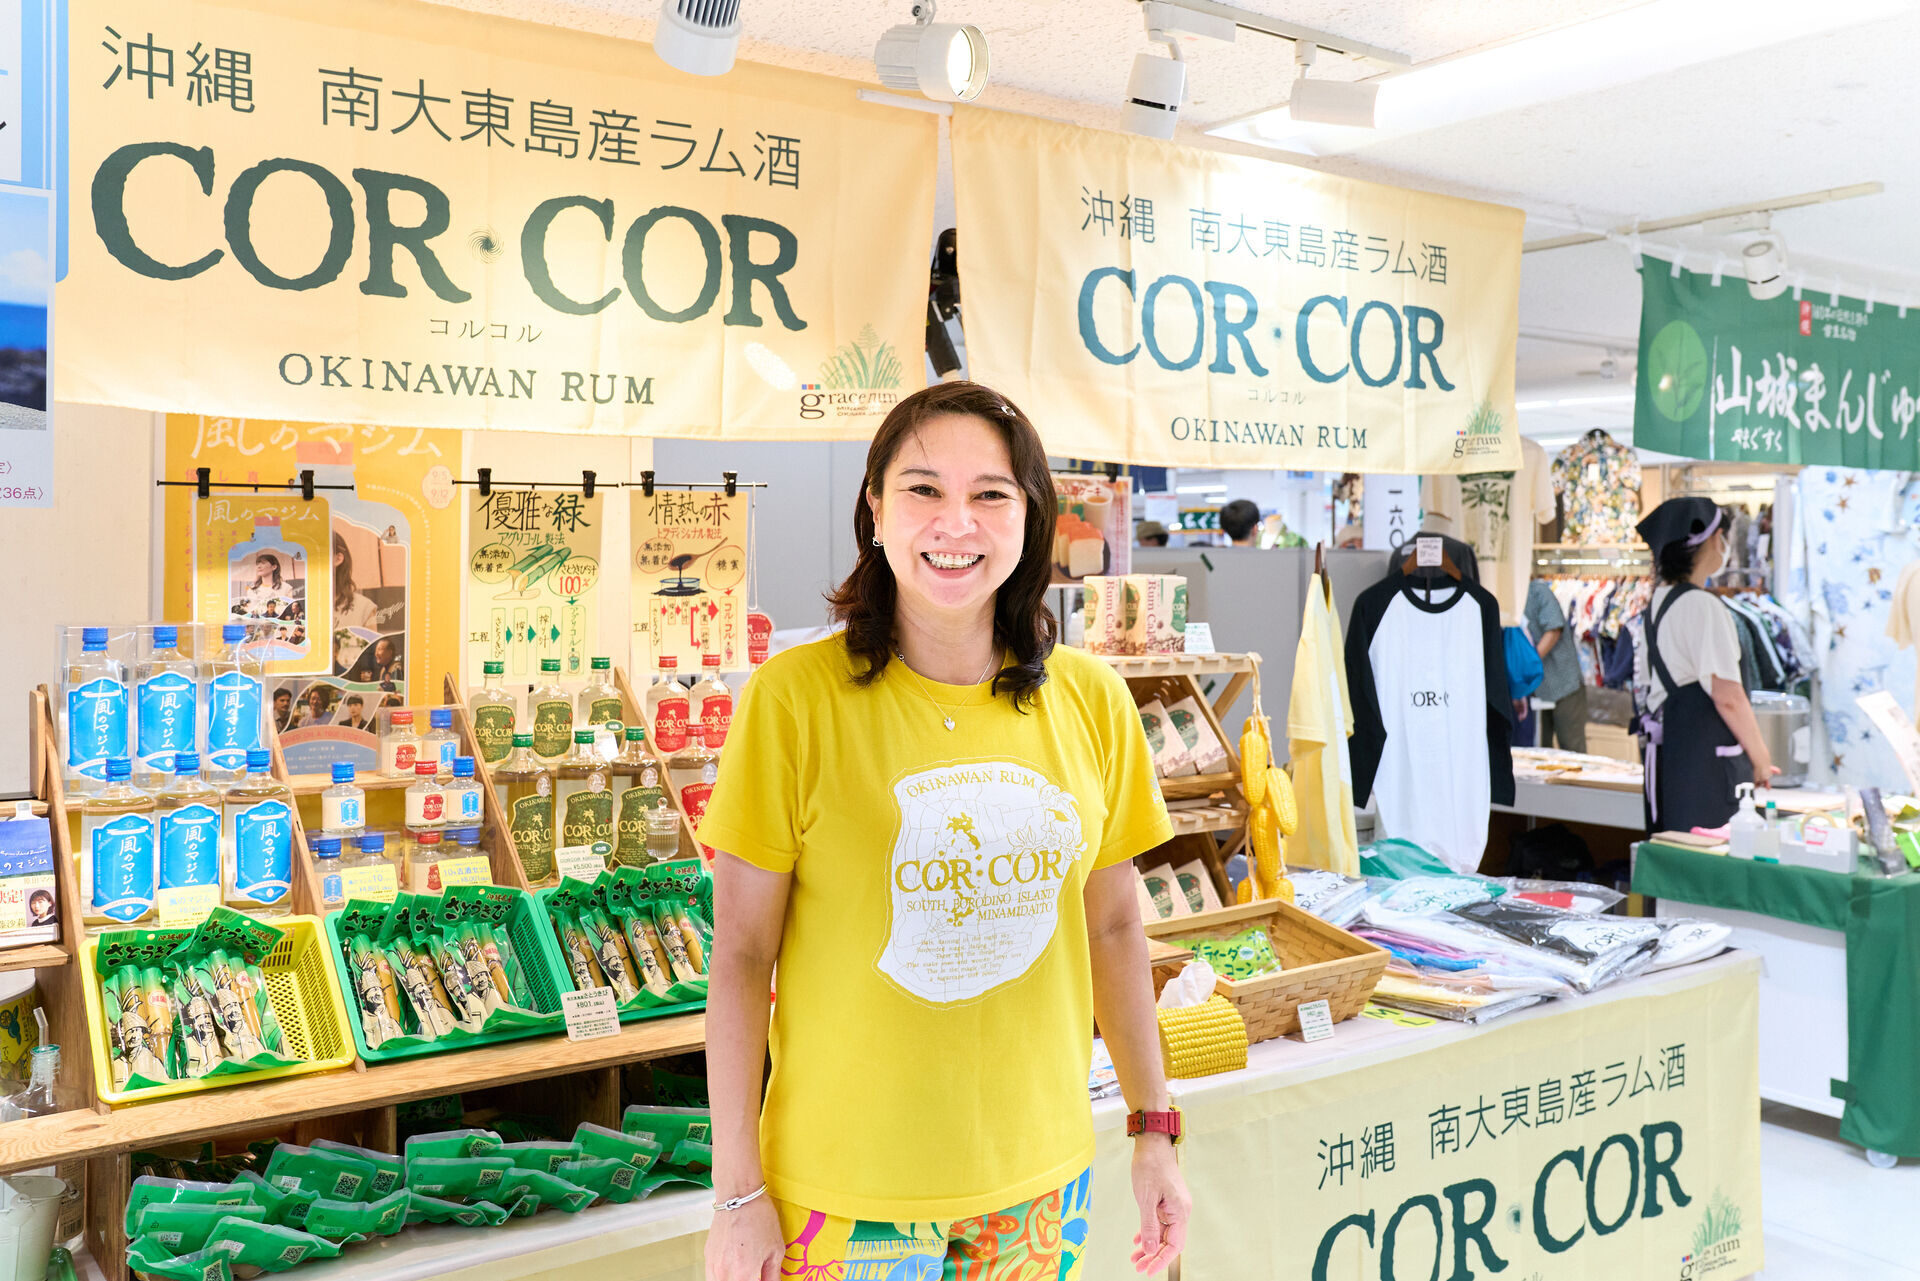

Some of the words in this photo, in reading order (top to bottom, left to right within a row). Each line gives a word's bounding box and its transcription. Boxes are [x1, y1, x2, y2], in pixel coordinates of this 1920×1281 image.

[102, 26, 255, 114] 沖縄
[318, 66, 801, 190] 南大東島産ラム酒
[91, 141, 472, 304] COR
[521, 194, 808, 331] COR
[1080, 186, 1156, 245] 沖縄
[1188, 206, 1448, 286] 南大東島産ラム酒
[430, 317, 543, 344] コルコル
[1078, 265, 1269, 377] COR
[1296, 294, 1456, 392] COR
[279, 353, 537, 399] OKINAWAN
[561, 371, 655, 405] RUM
[1247, 388, 1307, 405] コルコル
[1171, 416, 1305, 447] OKINAWAN
[1318, 424, 1368, 449] RUM
[207, 499, 320, 526] 風のマジム
[476, 491, 591, 533] 優雅な緑
[648, 492, 730, 526] 情熱の赤
[1106, 581, 1114, 611] Rum
[1147, 581, 1156, 611] Rum
[1410, 691, 1439, 707] OR
[95, 699, 115, 755] 風のマジム
[160, 692, 181, 748] 風のマジム
[224, 691, 244, 746] 風のマジム
[535, 723, 554, 734] COR
[656, 718, 675, 728] COR
[906, 770, 993, 798] OKINAWAN
[1000, 770, 1035, 788] RUM
[512, 830, 541, 843] COR
[564, 824, 593, 838] COR
[619, 820, 647, 833] COR
[0, 855, 48, 873] のマジム
[184, 826, 206, 884] 風のマジム
[260, 821, 281, 879] 風のマジム
[119, 836, 142, 896] 風のマジム
[895, 858, 977, 893] COR
[988, 849, 1064, 886] COR
[638, 875, 700, 900] さとうきび
[906, 899, 946, 913] SOUTH
[953, 893, 1012, 911] BORODINO
[1017, 888, 1056, 903] ISLAND
[445, 896, 512, 921] さとうきび
[976, 901, 1053, 922] MINAMIDAITO
[200, 920, 270, 952] さとうきび
[1224, 962, 1254, 976] コーン
[1317, 1121, 1396, 1190] 沖縄
[1427, 1043, 1687, 1160] 南大東島産ラム酒
[1312, 1177, 1509, 1281] COR
[1532, 1120, 1692, 1254] COR
